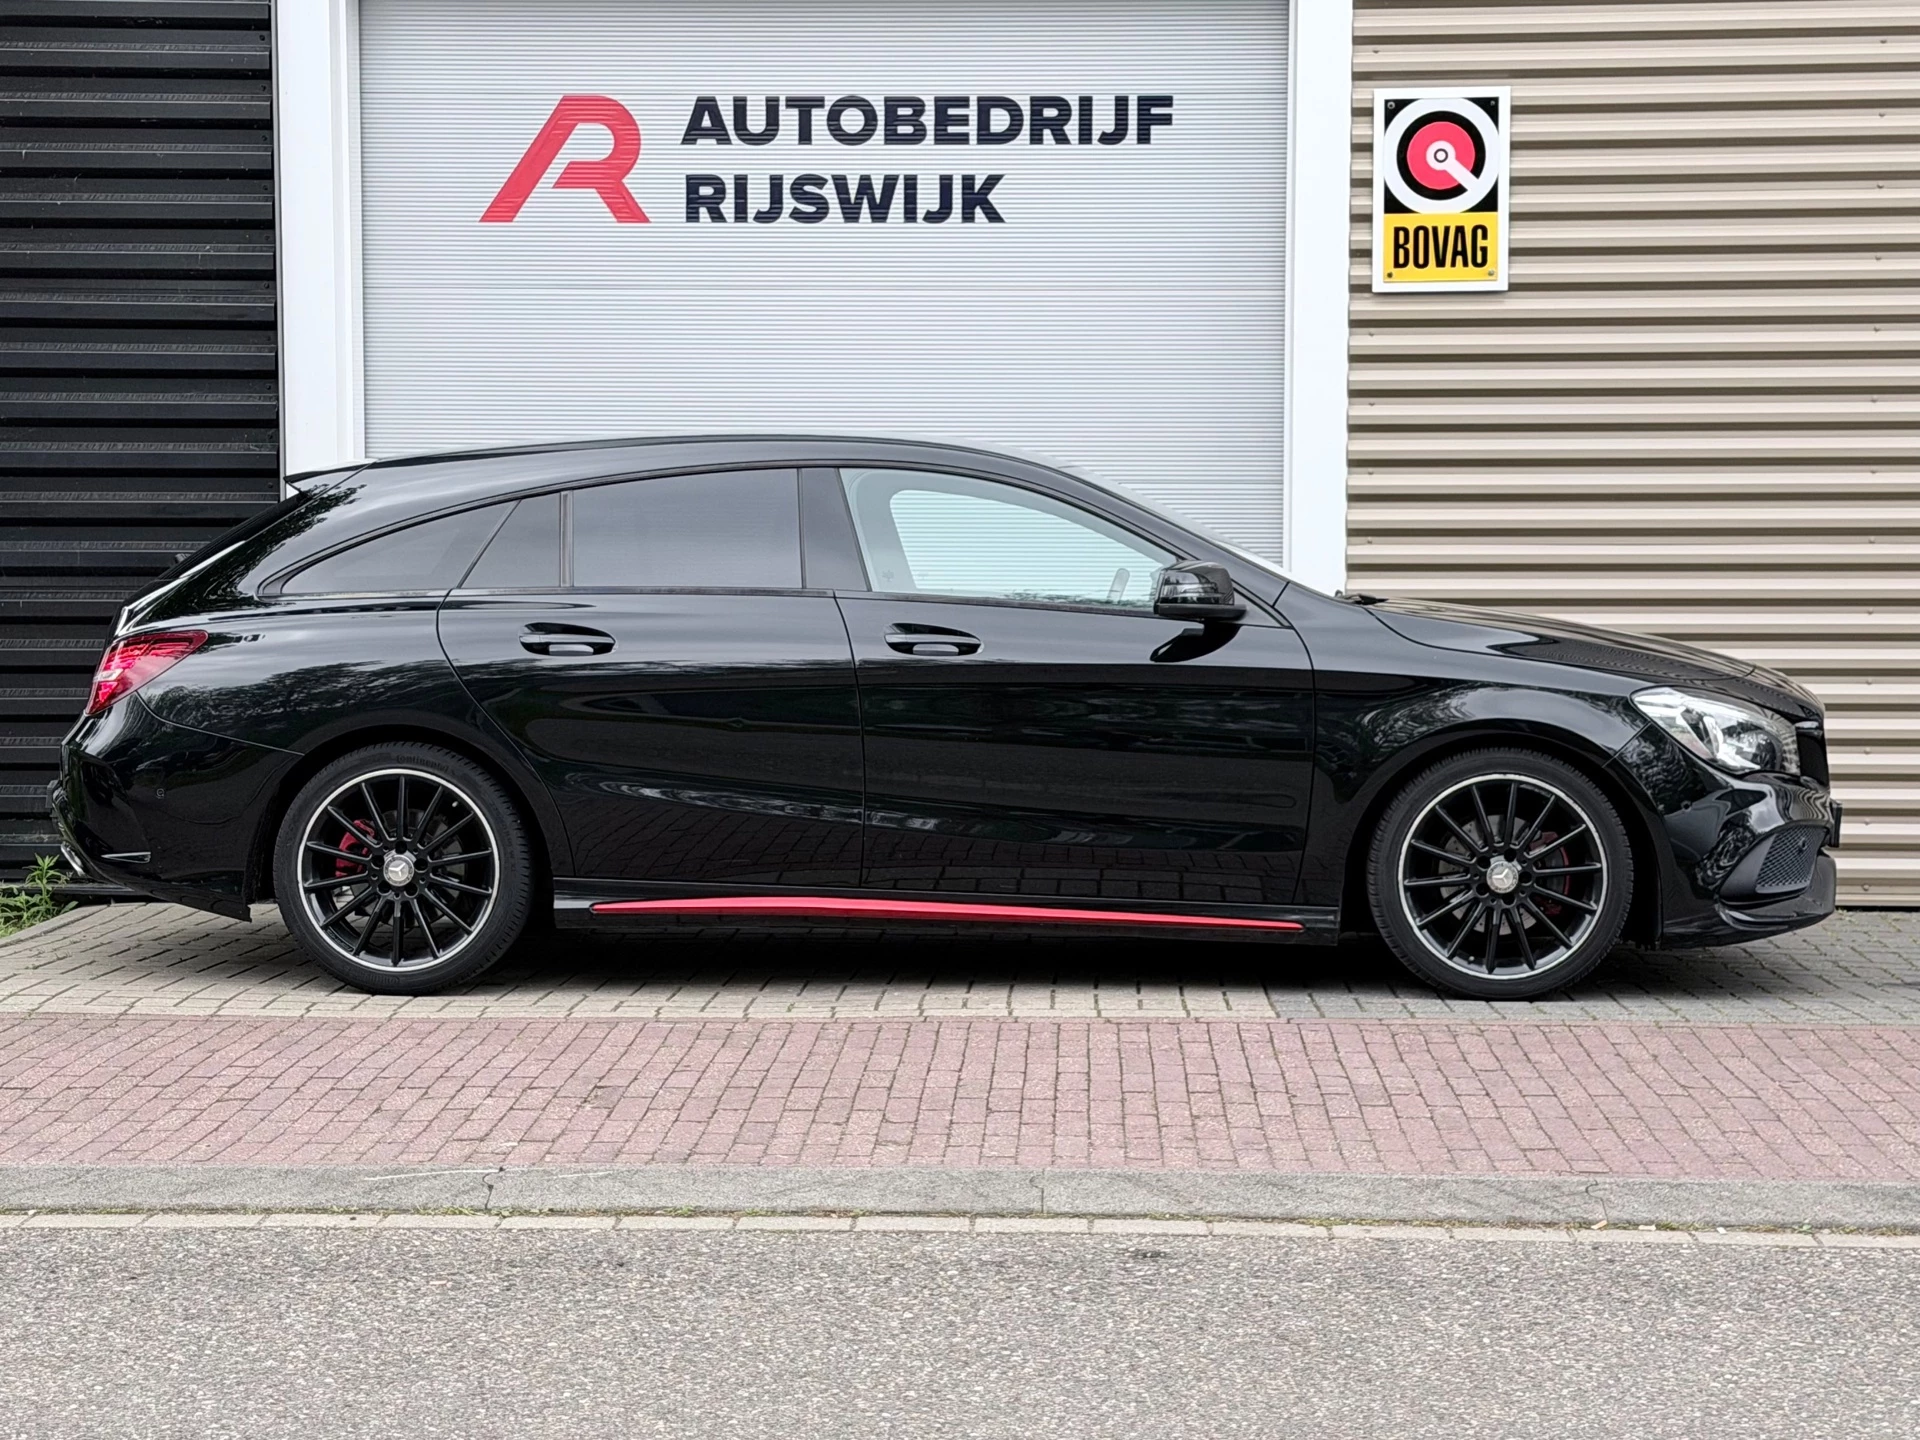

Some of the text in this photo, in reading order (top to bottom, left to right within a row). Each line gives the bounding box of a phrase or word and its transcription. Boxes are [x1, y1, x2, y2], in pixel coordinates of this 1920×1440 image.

[680, 95, 1174, 146] AUTOBEDRIJF
[685, 174, 1006, 223] RIJSWIJK
[1393, 224, 1488, 269] BOVAG
